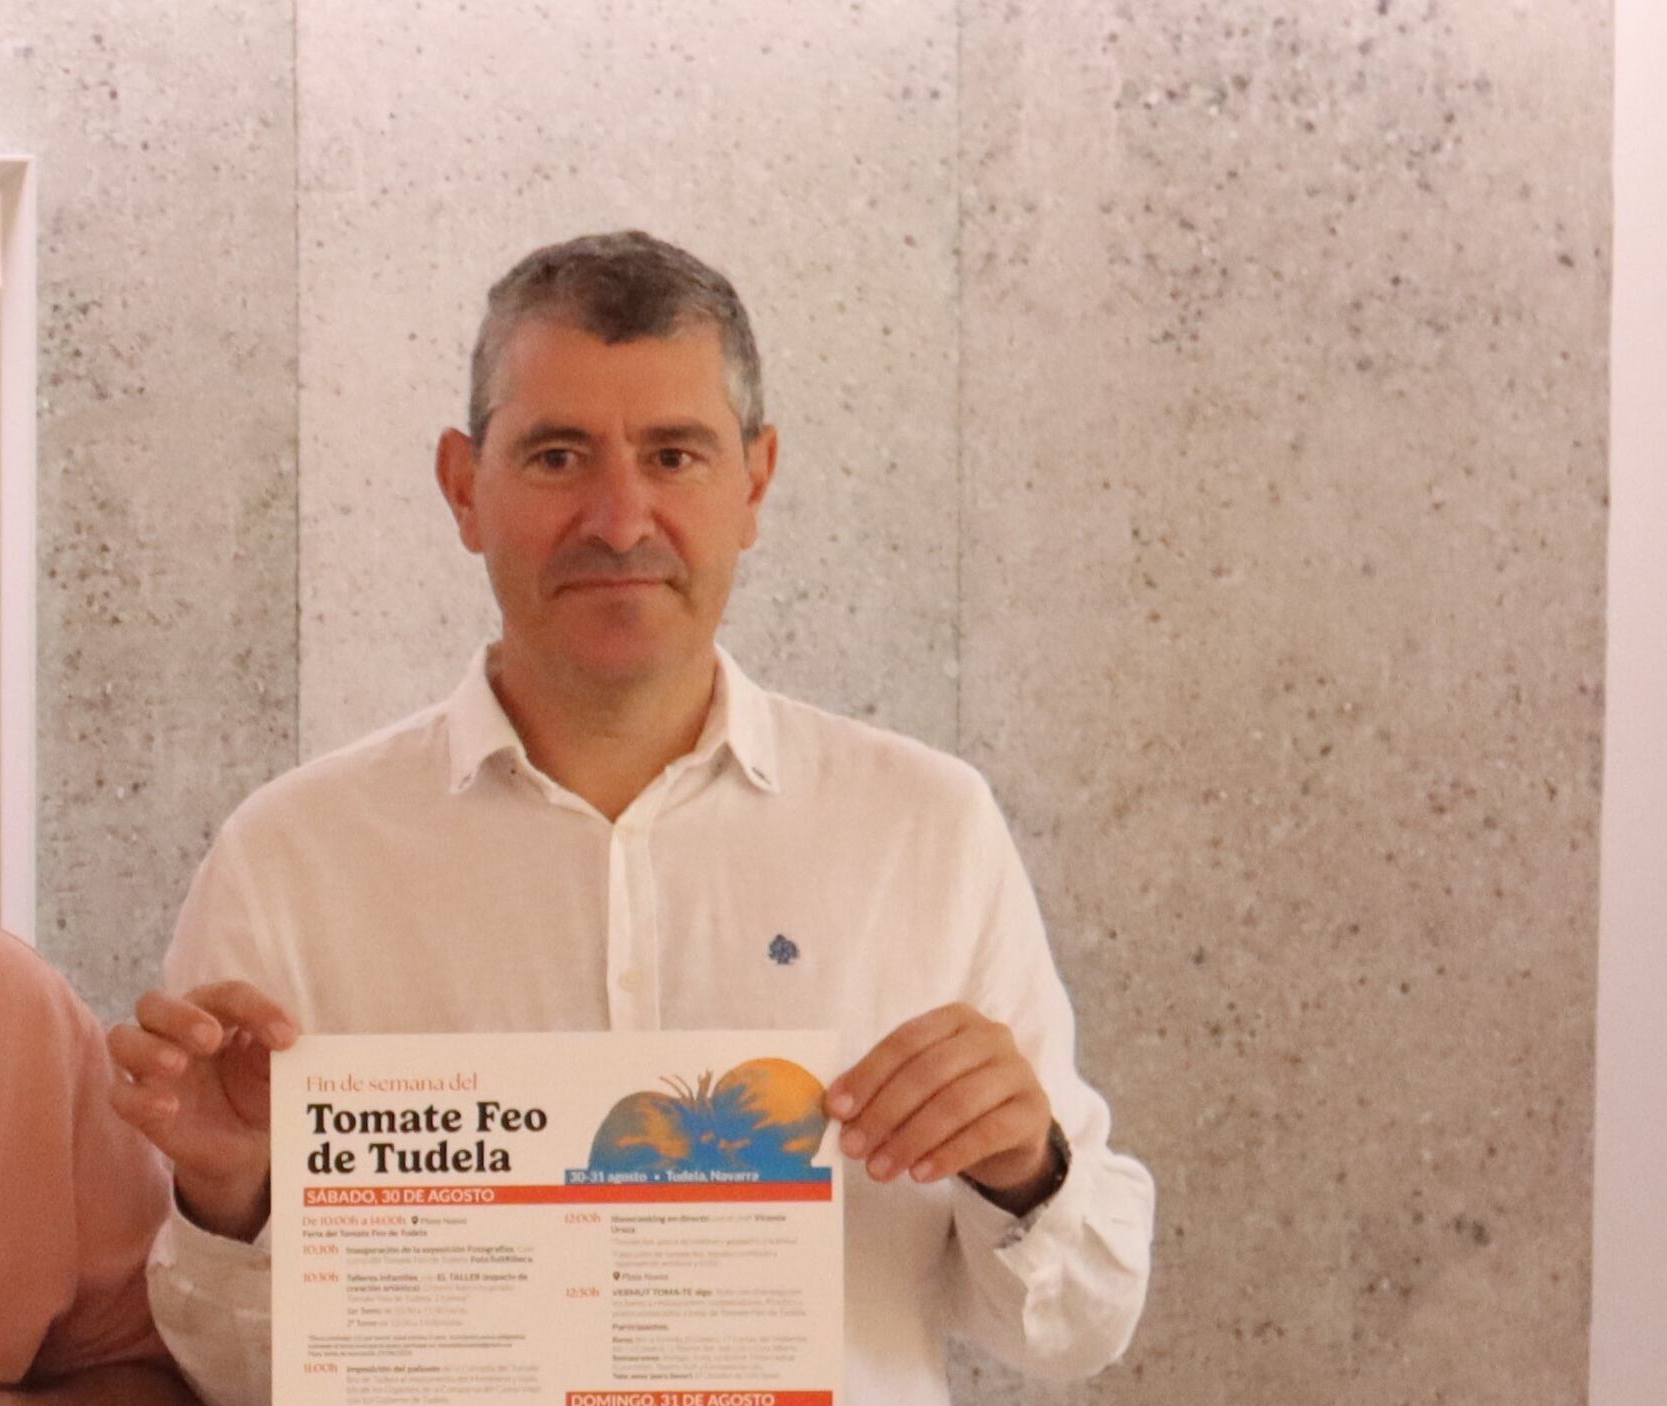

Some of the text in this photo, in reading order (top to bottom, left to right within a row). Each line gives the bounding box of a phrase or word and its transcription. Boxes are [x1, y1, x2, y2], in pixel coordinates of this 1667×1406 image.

[306, 1071, 478, 1091] Fin de semana del
[306, 1101, 547, 1134] Tomate Feo
[307, 1139, 512, 1174] de Tudela
[570, 1171, 605, 1182] 30-31
[608, 1170, 647, 1184] agosto
[710, 1169, 759, 1181] Navarra
[307, 1187, 495, 1205] SÁBADO, 30 DE AGOSTO
[682, 1393, 704, 1406] DE
